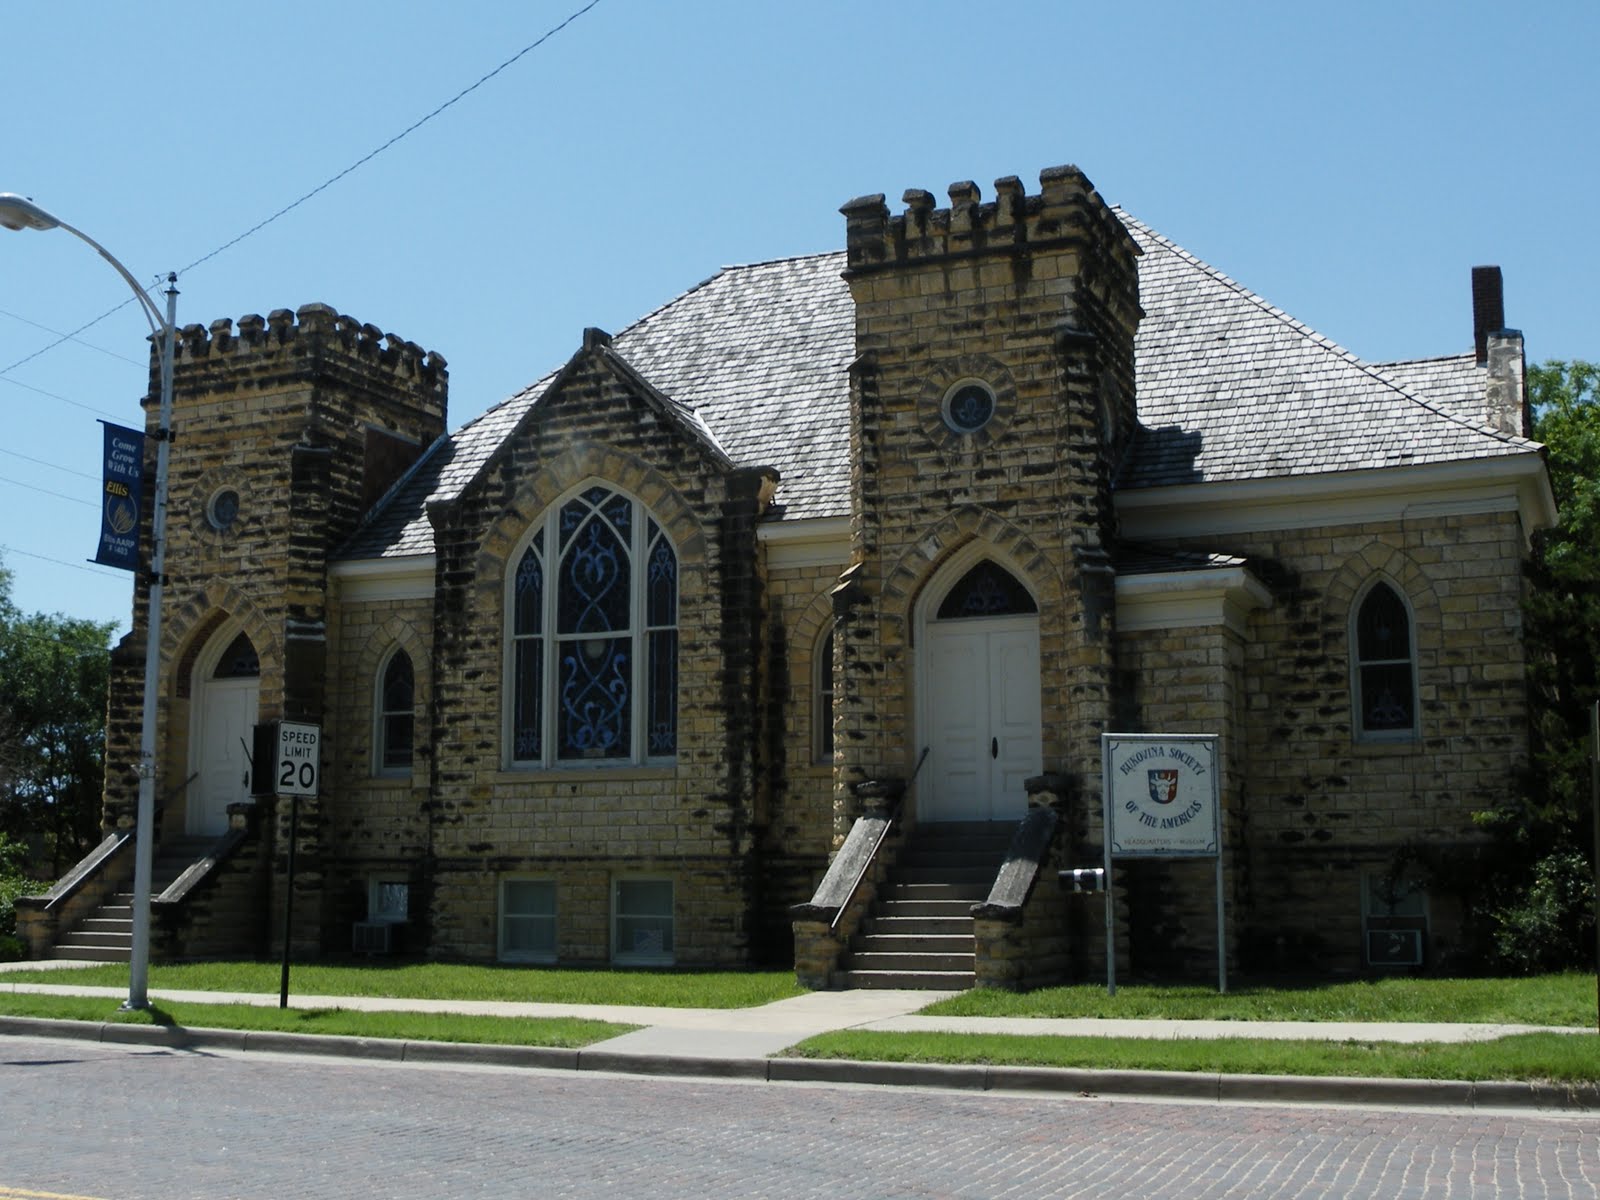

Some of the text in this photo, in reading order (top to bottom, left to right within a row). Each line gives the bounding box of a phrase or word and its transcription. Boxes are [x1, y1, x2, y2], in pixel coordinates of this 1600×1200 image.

[112, 437, 136, 452] Come
[111, 450, 135, 463] Grow
[107, 459, 140, 478] With Us
[106, 480, 128, 496] Ellis
[282, 731, 317, 745] SPEED
[284, 746, 312, 758] LIMIT
[1120, 746, 1206, 776] BUKOVINA SOCIETY
[280, 760, 315, 789] 20
[1125, 799, 1202, 830] OF THE AMERICAS
